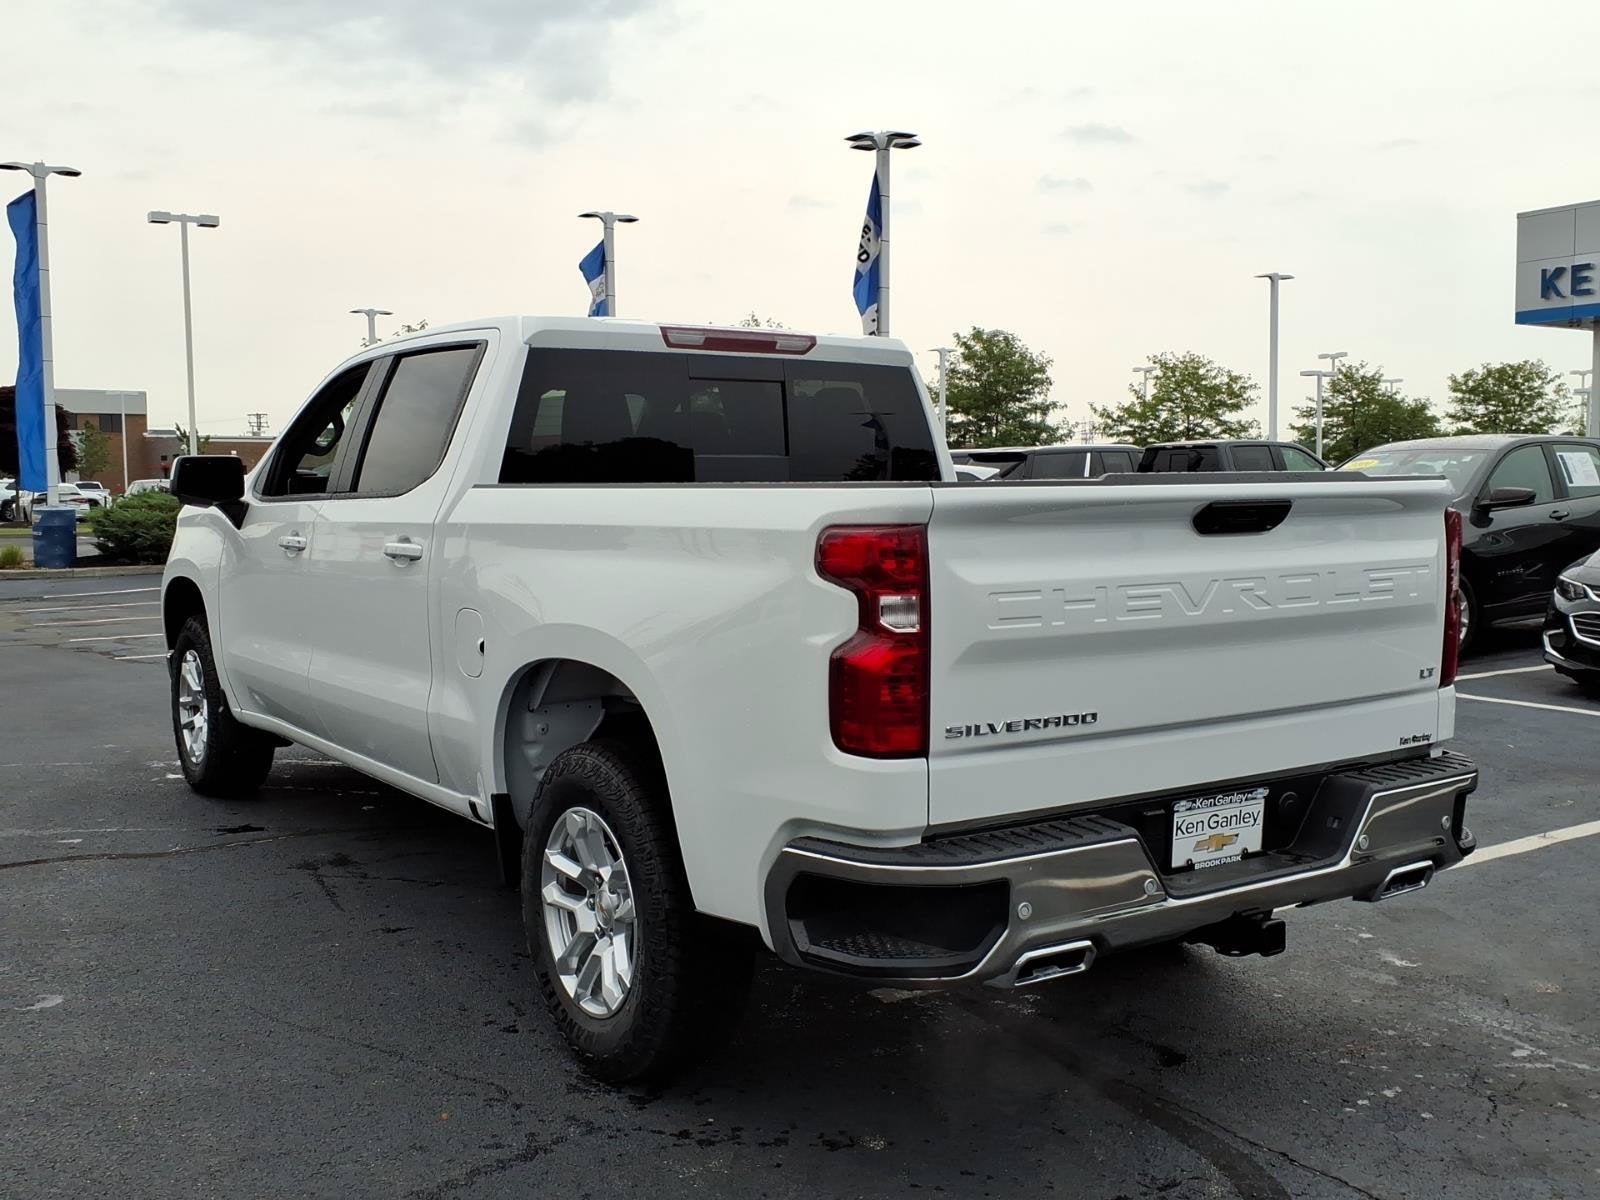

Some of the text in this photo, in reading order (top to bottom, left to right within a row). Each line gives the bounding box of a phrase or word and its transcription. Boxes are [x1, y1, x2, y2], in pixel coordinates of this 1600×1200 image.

[987, 564, 1430, 629] CHEVROLET
[1419, 667, 1435, 679] LT
[944, 711, 1098, 739] SILVERADO
[1196, 792, 1247, 809] Ken Ganley
[1175, 809, 1261, 837] Ken Ganley
